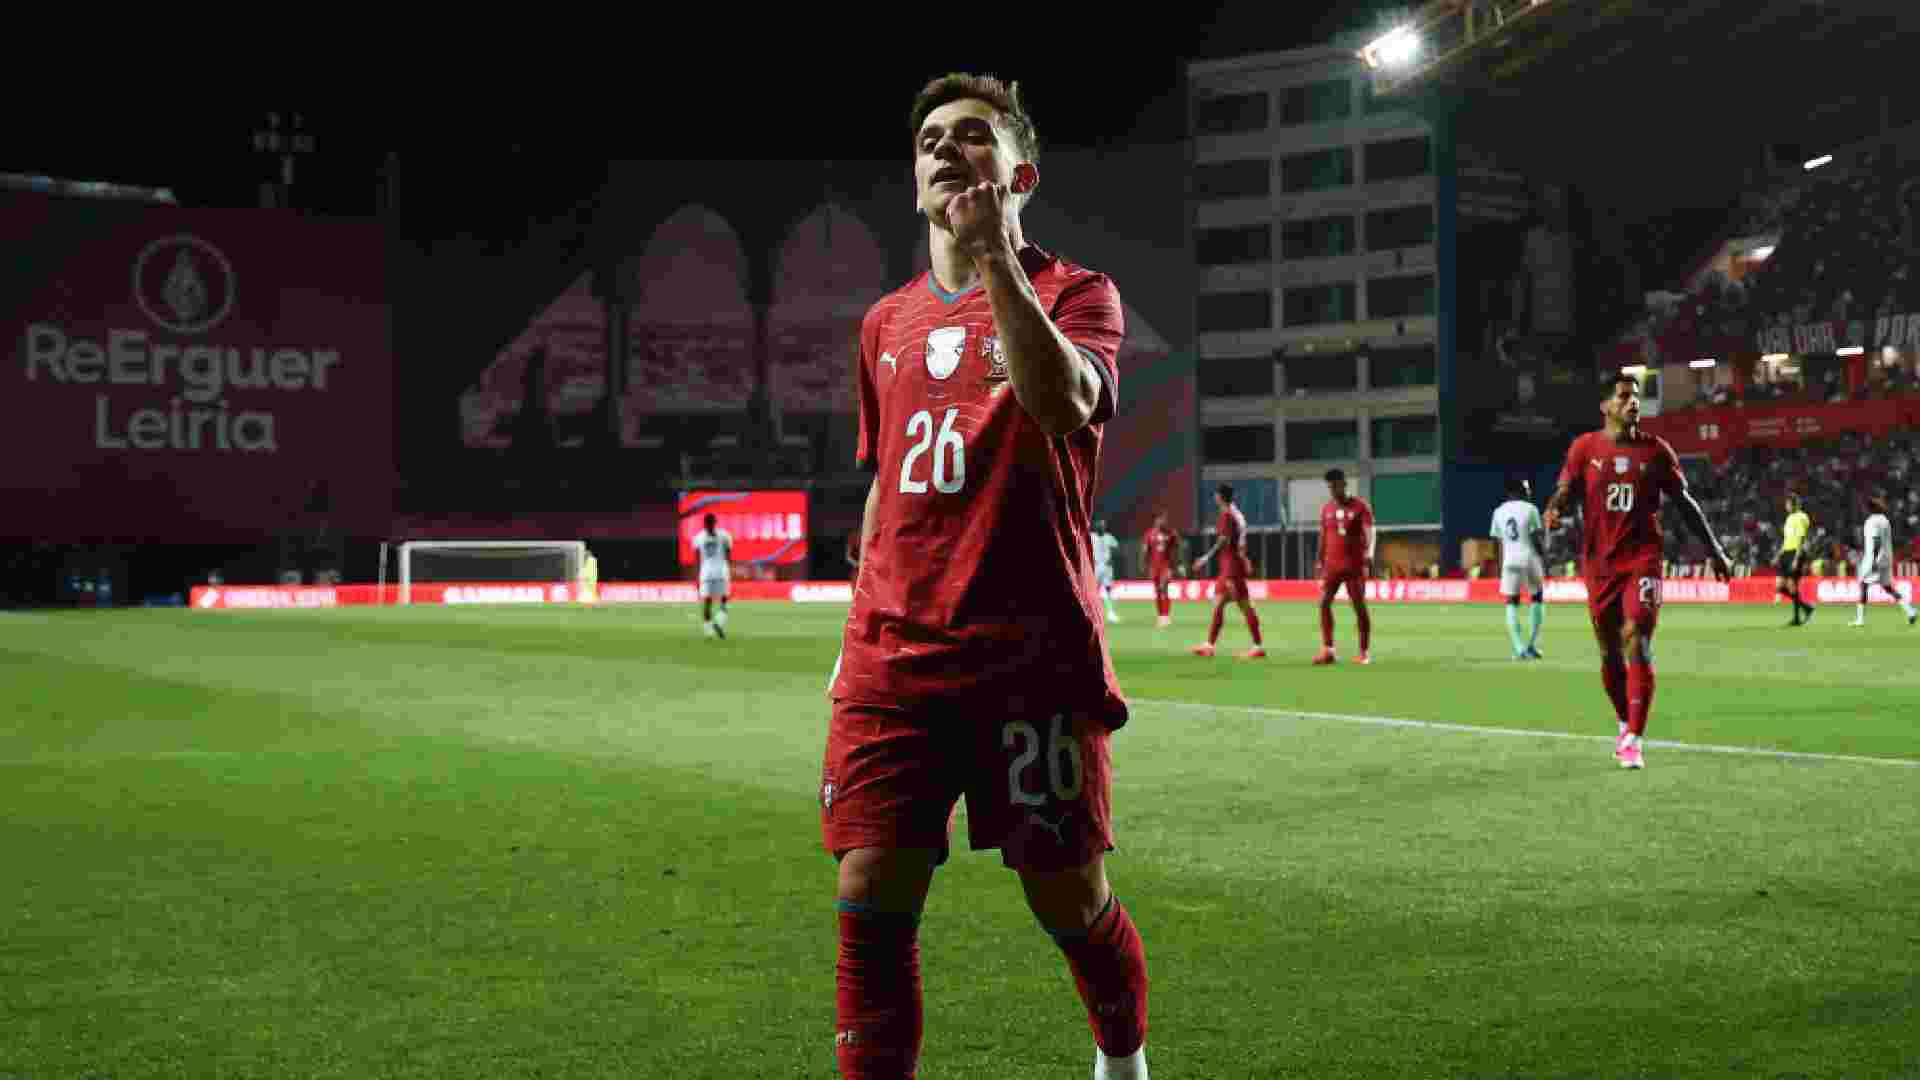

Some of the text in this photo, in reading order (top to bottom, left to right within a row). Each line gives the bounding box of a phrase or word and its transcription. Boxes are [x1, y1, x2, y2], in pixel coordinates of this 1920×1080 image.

[26, 324, 338, 401] ReErguer
[94, 396, 277, 451] Leiria
[899, 408, 965, 495] 26
[1505, 516, 1519, 542] 3
[1606, 482, 1634, 513] 20
[1002, 713, 1084, 806] 26
